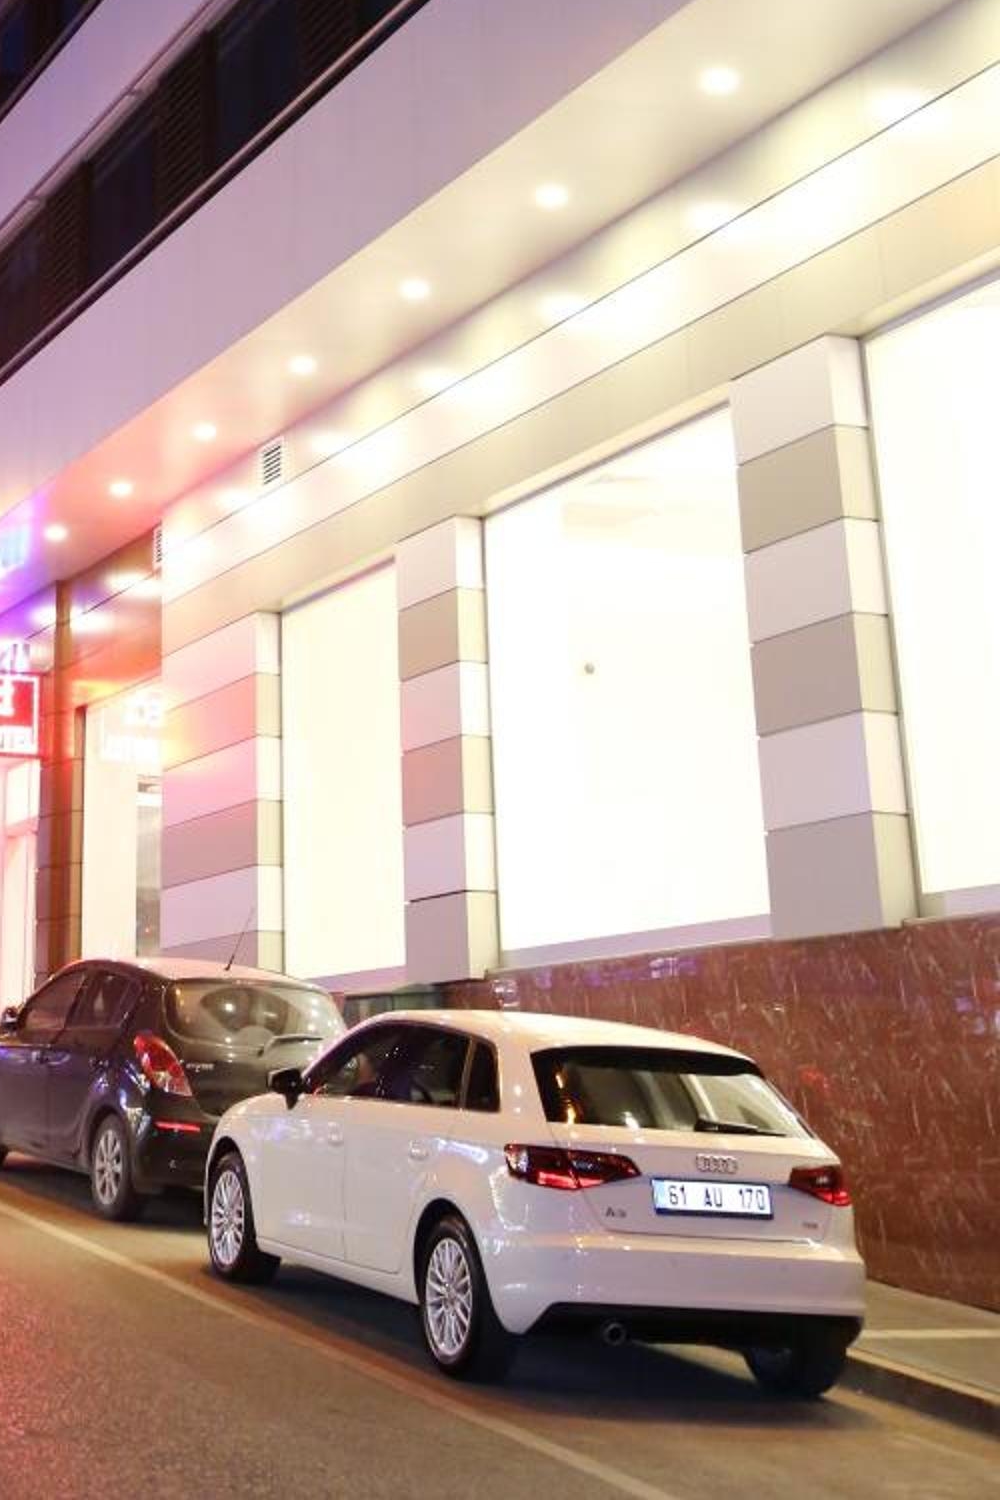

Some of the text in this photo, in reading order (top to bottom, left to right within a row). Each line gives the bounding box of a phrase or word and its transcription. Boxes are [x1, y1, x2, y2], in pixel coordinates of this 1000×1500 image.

[669, 1185, 766, 1210] 61 AU 170
